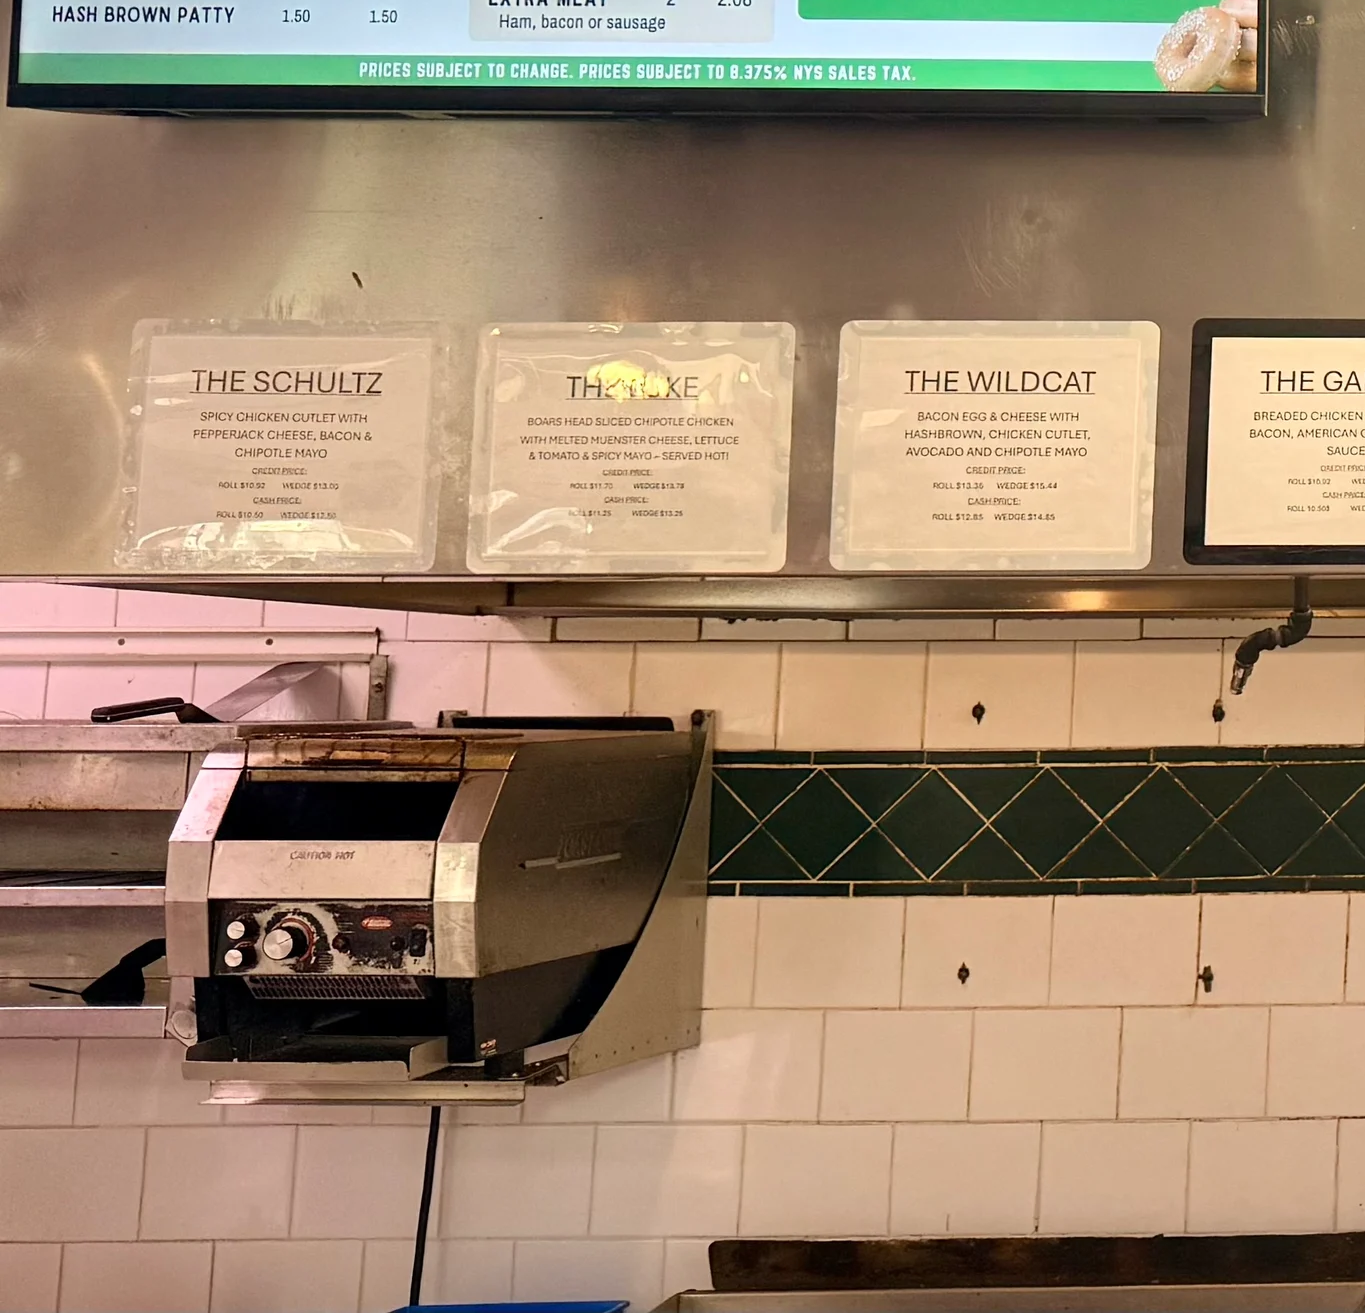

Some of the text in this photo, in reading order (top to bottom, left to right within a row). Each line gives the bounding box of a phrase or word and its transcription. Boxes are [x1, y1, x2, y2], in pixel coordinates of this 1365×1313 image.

[359, 62, 916, 81] PRICES SUBJECT TO CHANGE. PRICES SUBJECT TO 8.375% NYS SALES TAX.
[192, 370, 383, 395] THE SCHULTZ
[905, 370, 1097, 394] THE WILDCAT
[1260, 371, 1315, 394] THE
[200, 411, 367, 423] SPICY CHICKEN CUTLET WITH
